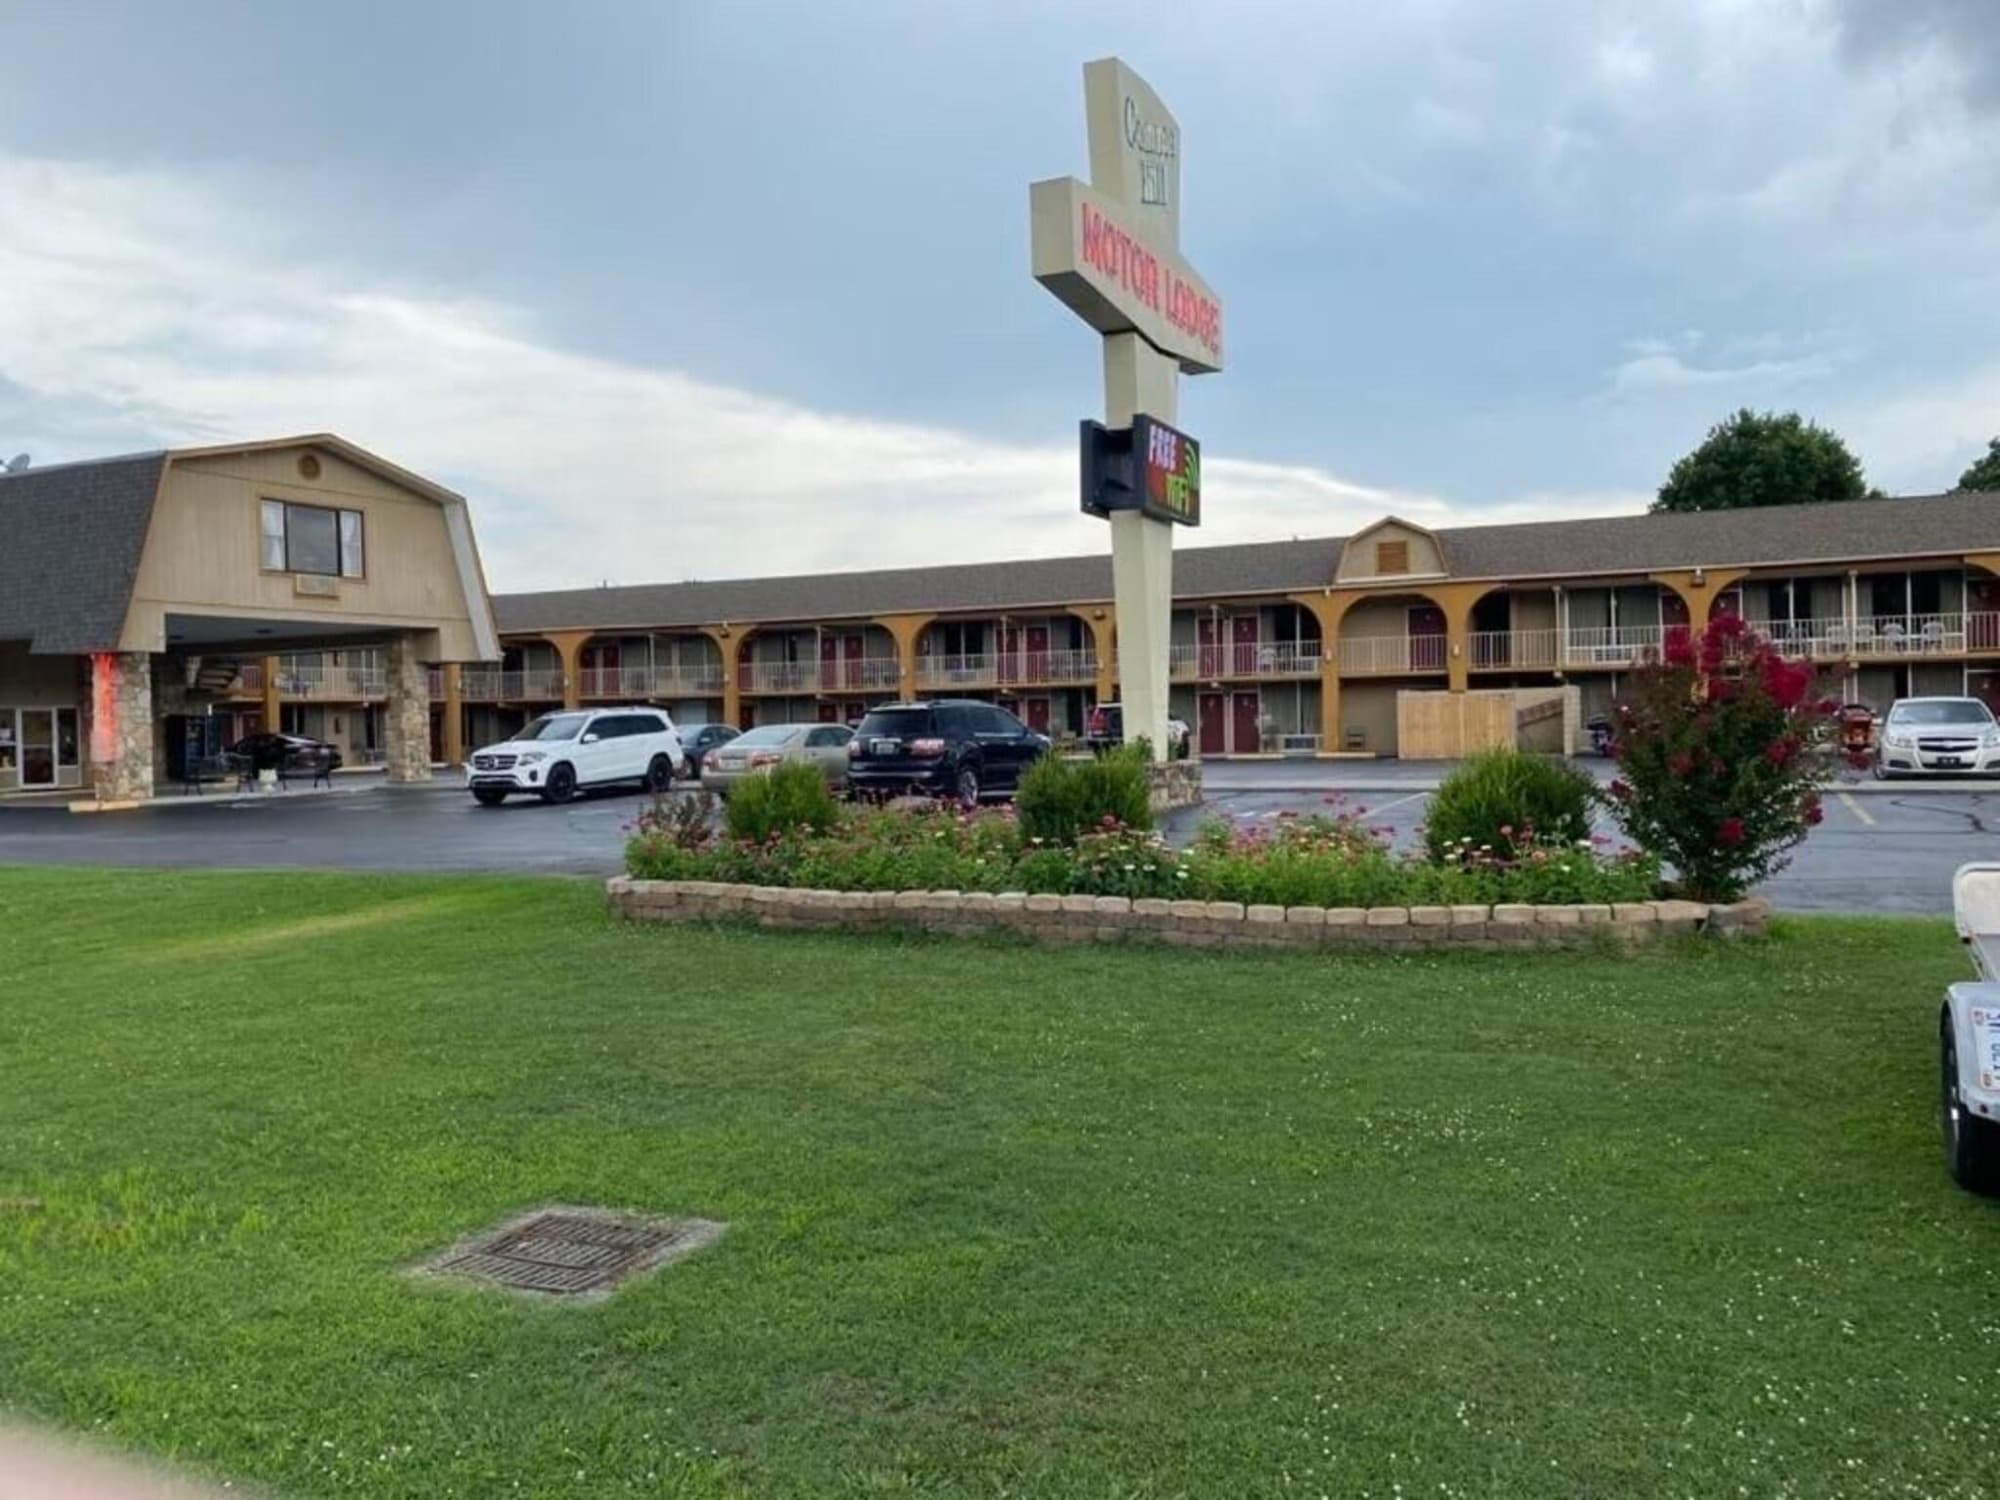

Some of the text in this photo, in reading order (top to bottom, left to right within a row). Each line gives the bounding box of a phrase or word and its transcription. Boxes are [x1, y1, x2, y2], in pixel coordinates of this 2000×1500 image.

[1081, 202, 1220, 355] MOTOR LODGE
[1149, 424, 1177, 472] FREE
